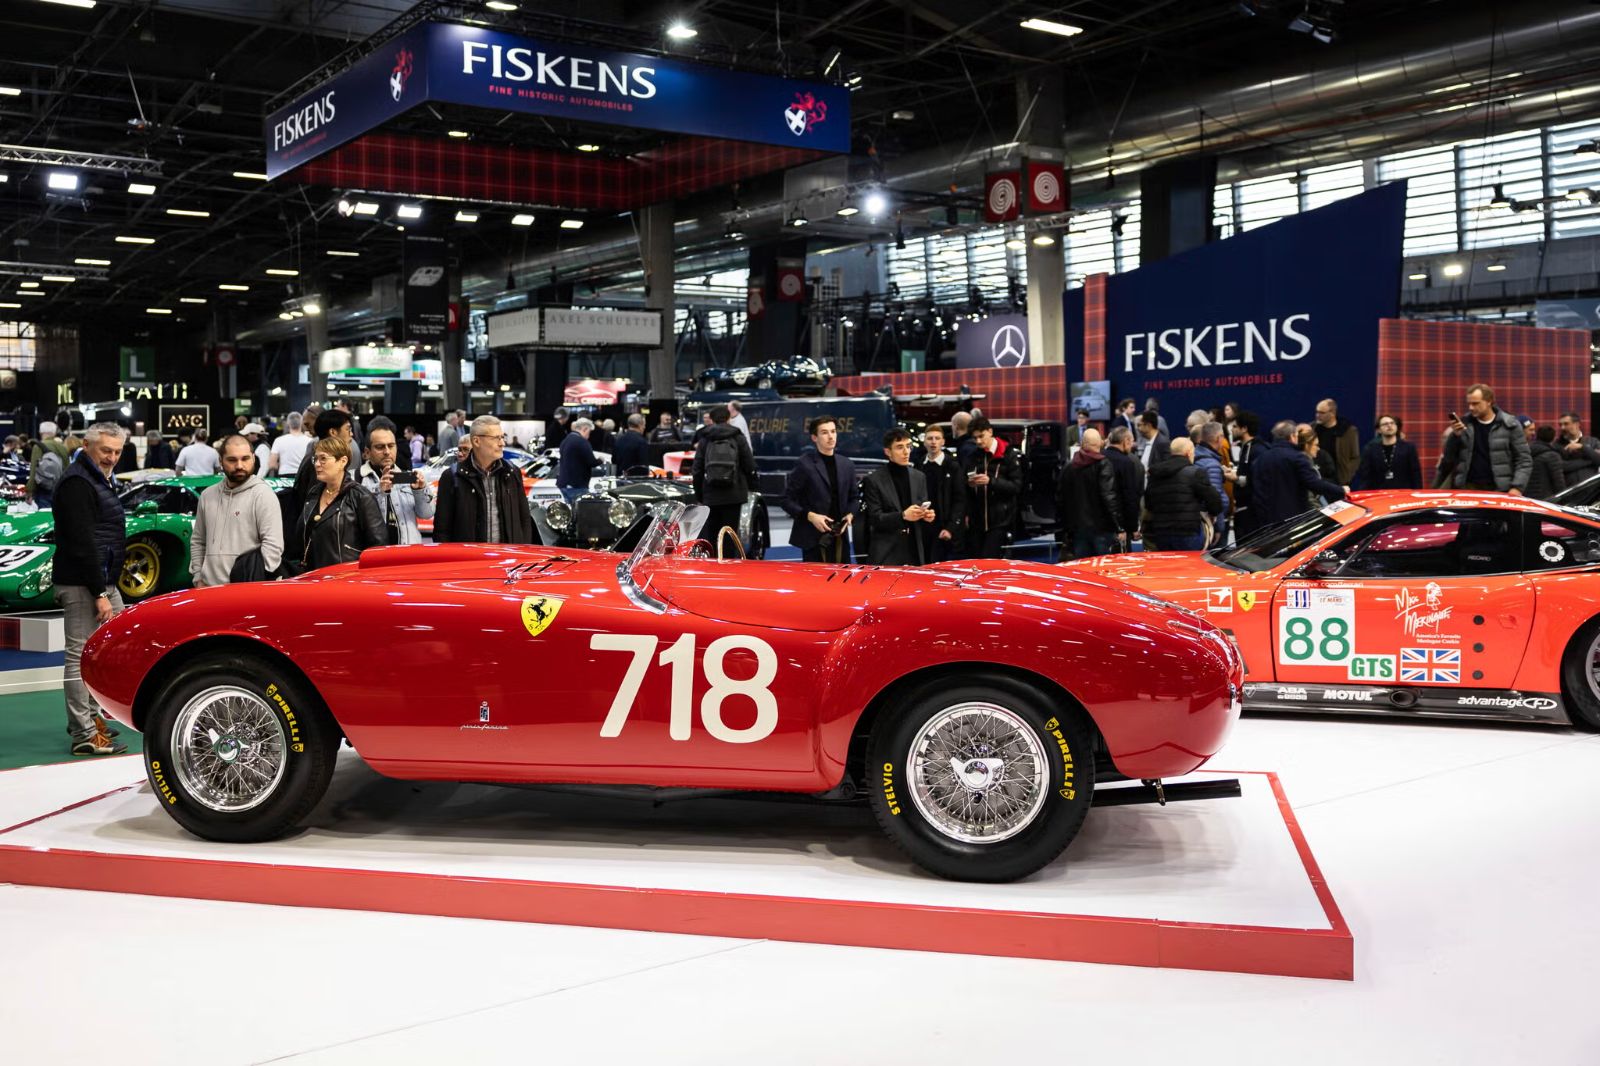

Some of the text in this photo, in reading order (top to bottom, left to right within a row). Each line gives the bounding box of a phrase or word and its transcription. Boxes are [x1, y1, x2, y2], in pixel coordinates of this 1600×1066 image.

[461, 40, 657, 99] FISKENS
[489, 84, 633, 111] FINE HISTORIC AUTOMOBILES
[274, 90, 336, 152] FISKENS
[550, 314, 583, 325] AXEL
[589, 316, 657, 328] SCHUETTE
[1124, 313, 1312, 372] FISKENS
[1144, 373, 1283, 390] FINE HISTORIC AUTOMOBILES
[749, 417, 790, 433] ECURIE
[1284, 617, 1350, 661] 88
[590, 633, 778, 744] 718
[1351, 657, 1393, 678] GTS
[272, 692, 300, 743] PIRELLI
[1322, 689, 1373, 701] MOTUL
[1053, 729, 1075, 788] PIRELLI
[151, 760, 178, 806] STELVIO
[882, 762, 901, 816] STELVIO
